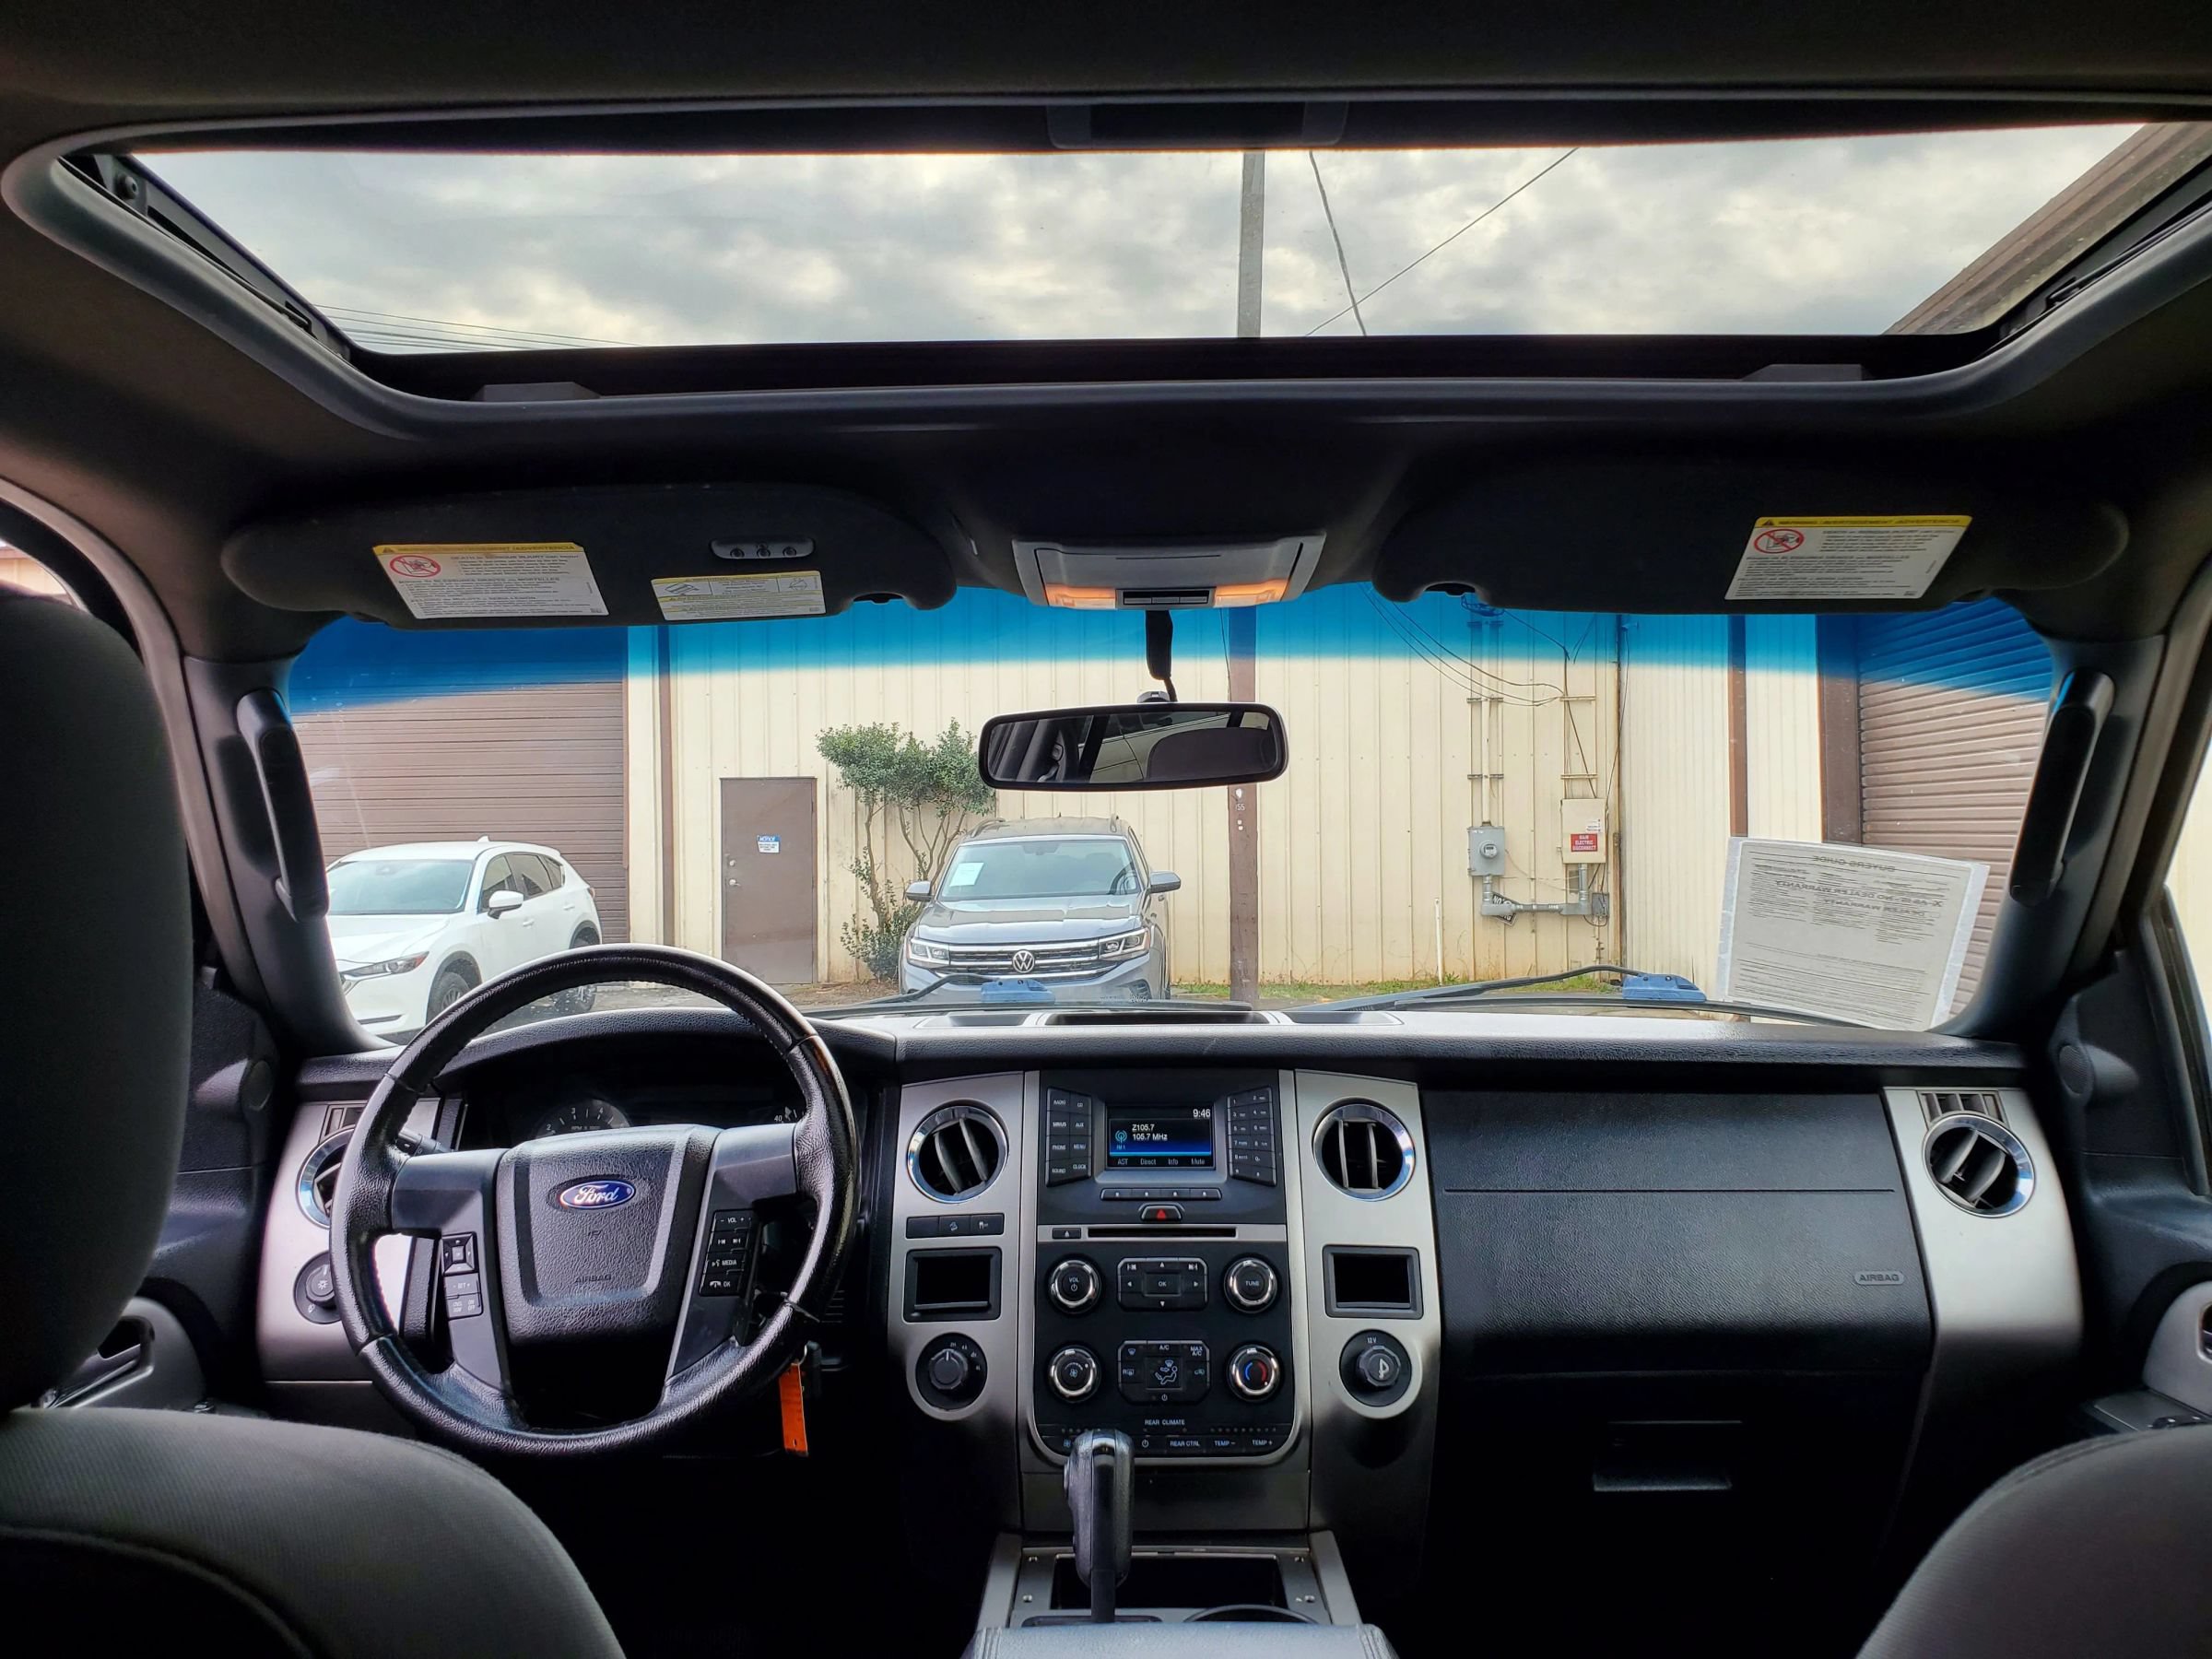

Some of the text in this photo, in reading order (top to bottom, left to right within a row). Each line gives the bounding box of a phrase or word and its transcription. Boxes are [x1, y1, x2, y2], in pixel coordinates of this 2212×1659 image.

[1193, 1109, 1211, 1118] 9:46
[1132, 1124, 1155, 1132] Z105.7
[1133, 1133, 1168, 1141] 105.7 MHz
[1140, 1158, 1157, 1166] Direct
[1168, 1158, 1179, 1166] Info
[1191, 1158, 1206, 1166] Mute
[573, 1183, 619, 1204] Ford
[575, 1274, 612, 1283] AIRBAG
